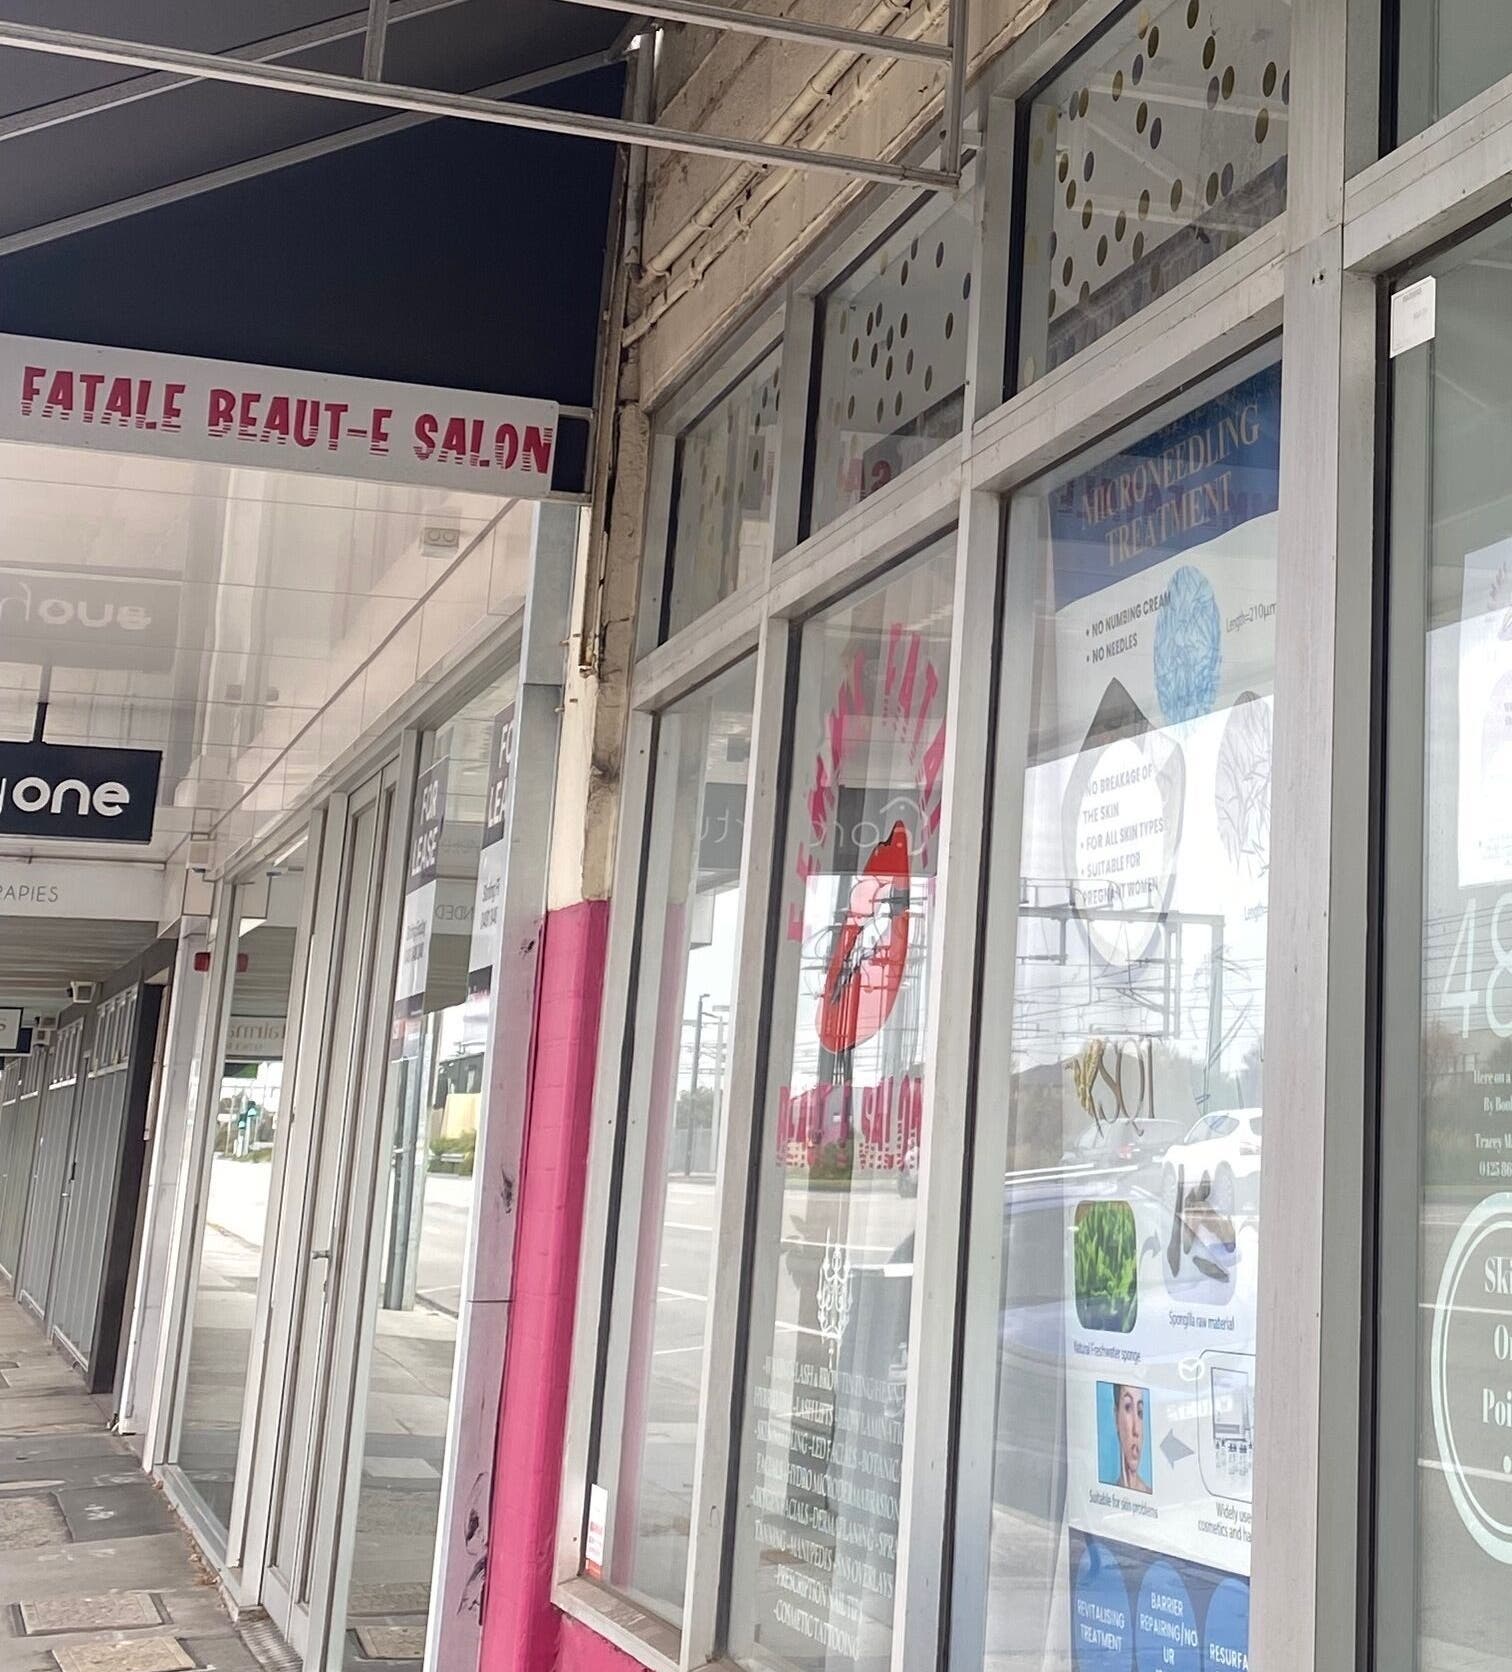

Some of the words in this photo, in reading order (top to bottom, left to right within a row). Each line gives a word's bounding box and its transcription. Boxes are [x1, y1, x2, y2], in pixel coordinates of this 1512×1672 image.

[20, 365, 187, 433] FATALE
[207, 387, 394, 456] BEAUT-E
[413, 411, 554, 475] SALON
[1081, 404, 1261, 531] MICRONEEDLING
[1104, 470, 1232, 568] TREATMENT
[1092, 622, 1104, 639] NO
[1105, 606, 1142, 635] NUMBING
[1142, 591, 1172, 616] CREAM
[1092, 648, 1105, 664] NO
[1106, 632, 1138, 661] NEEDLES
[1100, 766, 1141, 795] BREAKAGE
[1142, 763, 1153, 781] OF
[0, 776, 130, 818] one
[1083, 806, 1099, 824] THE
[1100, 802, 1120, 820] SKIN
[1086, 832, 1103, 851] FOR
[1105, 829, 1119, 847] ALL
[1120, 823, 1138, 843] SKIN
[1139, 818, 1164, 839] TYPES
[1087, 855, 1124, 878] SUITABLE
[1125, 851, 1141, 869] FOR
[1473, 1068, 1494, 1085] Here
[1483, 1096, 1494, 1116] By
[1475, 1132, 1502, 1153] Tracey
[1207, 1315, 1235, 1331] material
[1216, 1502, 1238, 1524] Widely
[1198, 1519, 1228, 1538] cosmetics
[1228, 1526, 1242, 1541] and
[1077, 1598, 1125, 1630] REVITALISING
[1151, 1591, 1184, 1617] BARRIER
[1080, 1623, 1123, 1652] TREATMENT
[1139, 1613, 1198, 1648] REPAIRING/NO
[1163, 1646, 1175, 1665] UR
